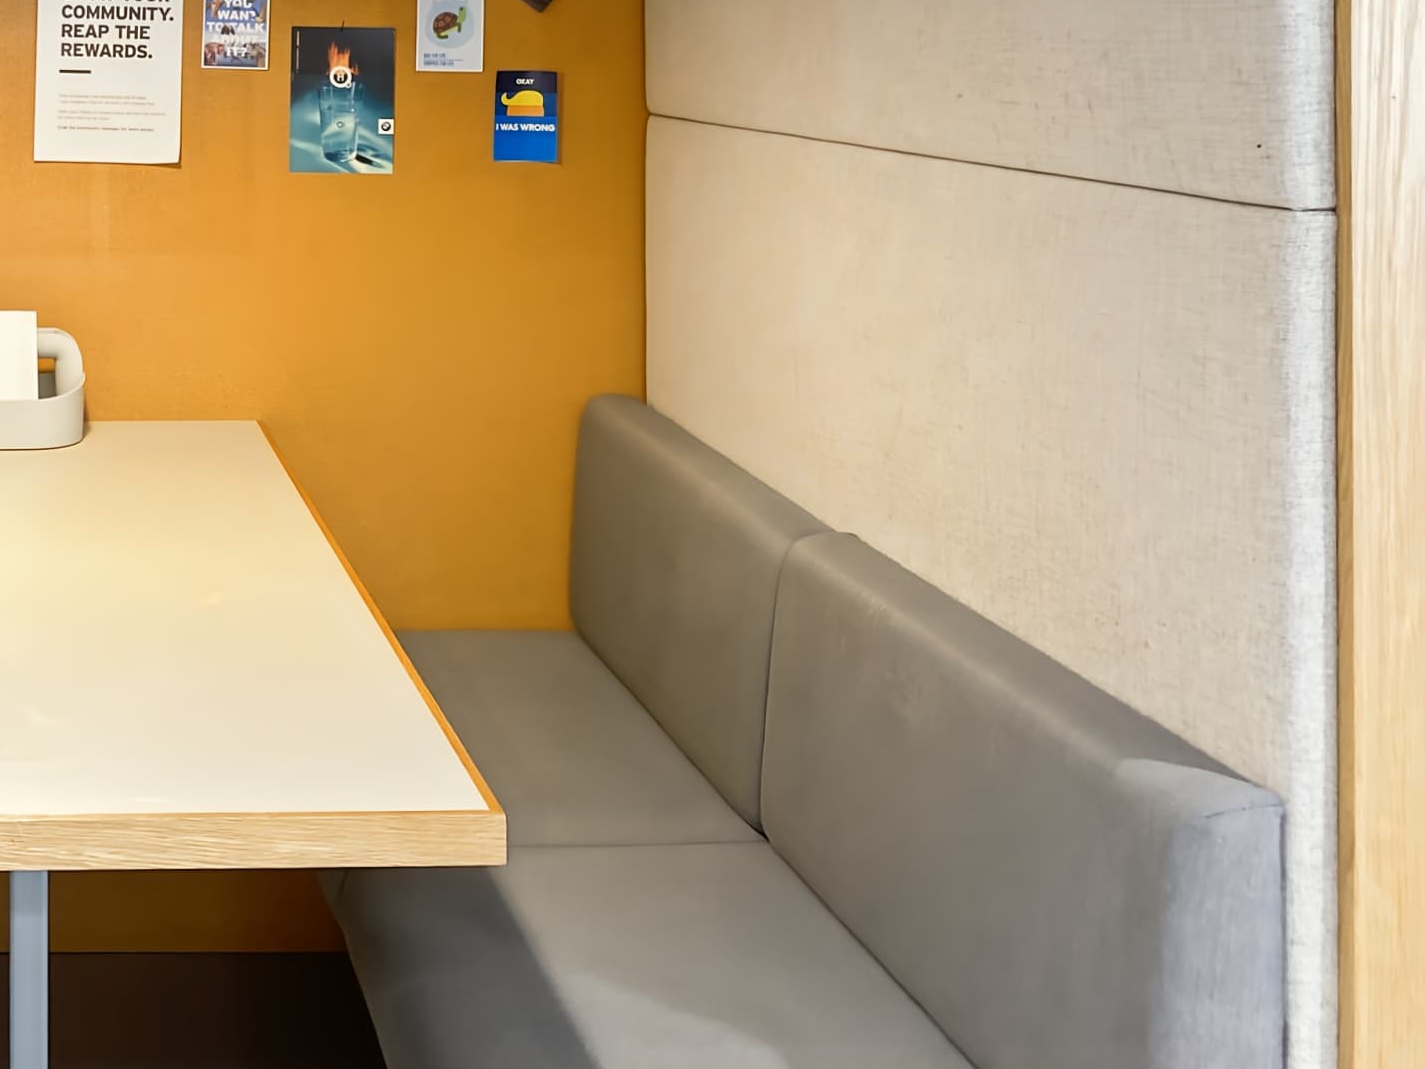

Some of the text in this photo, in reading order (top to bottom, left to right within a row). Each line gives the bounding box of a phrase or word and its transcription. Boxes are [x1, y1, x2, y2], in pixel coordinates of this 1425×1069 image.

[62, 5, 174, 21] COMMUNITY.
[61, 24, 150, 40] REAP THE
[229, 22, 265, 32] TALK
[61, 43, 153, 59] REWARDS.
[520, 124, 555, 132] WRONG
